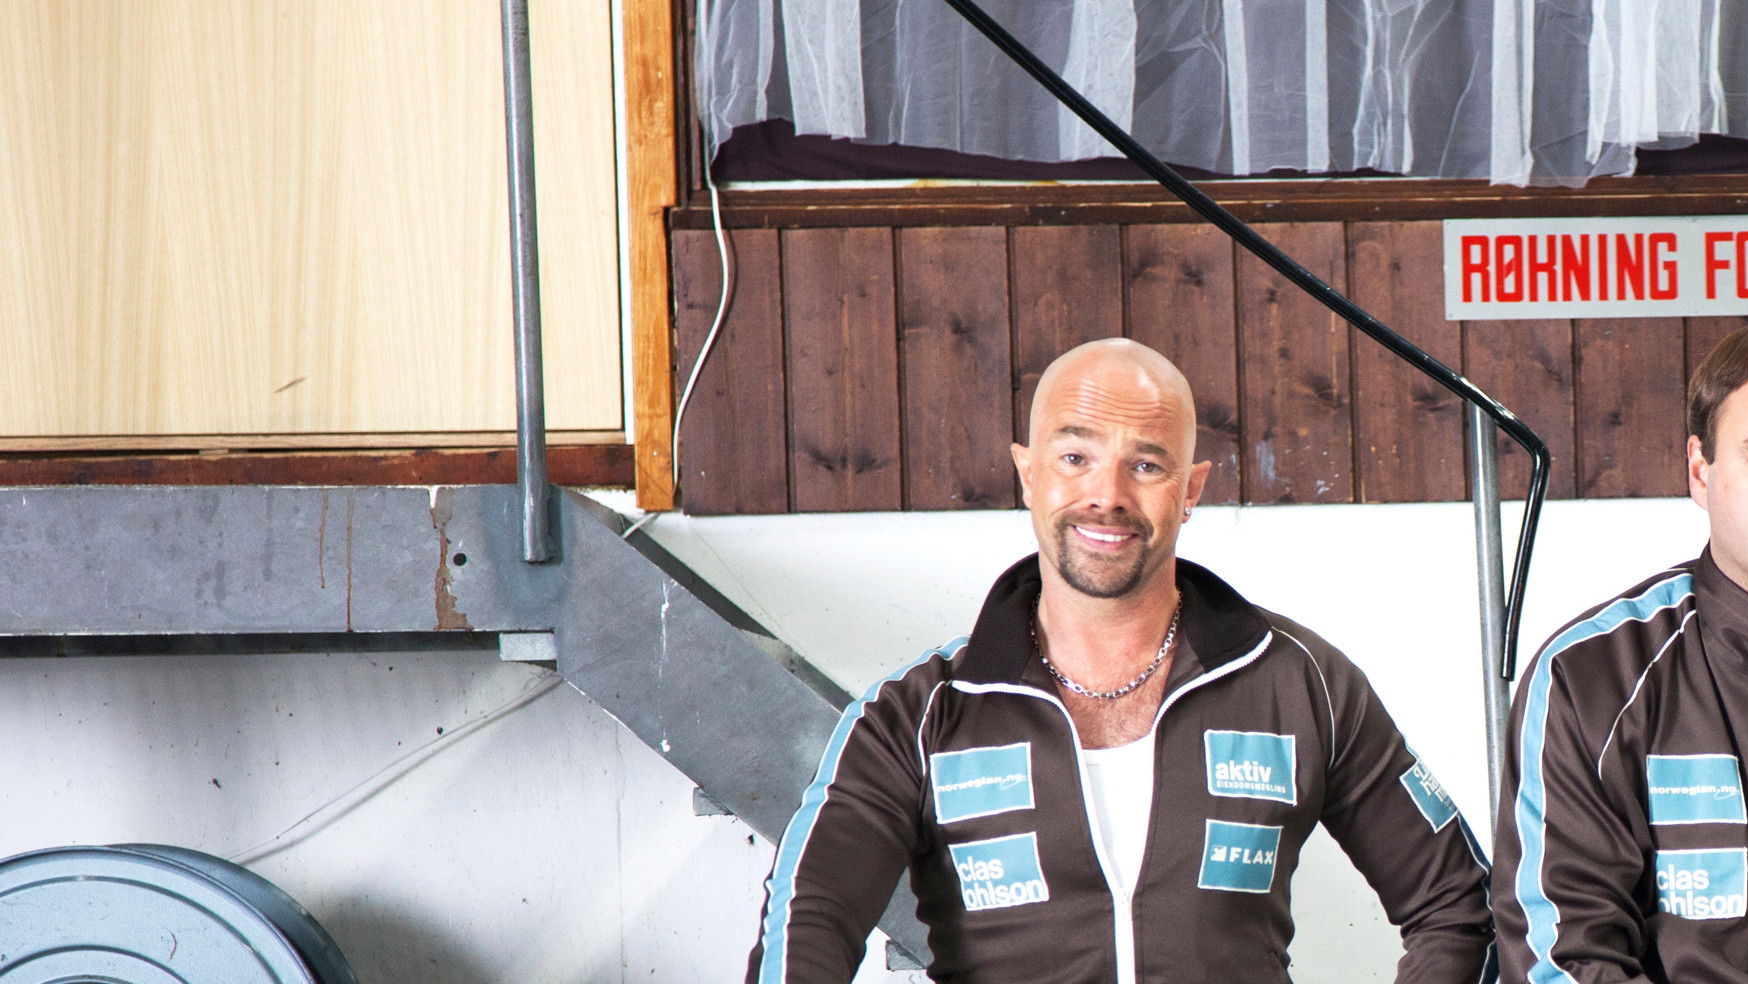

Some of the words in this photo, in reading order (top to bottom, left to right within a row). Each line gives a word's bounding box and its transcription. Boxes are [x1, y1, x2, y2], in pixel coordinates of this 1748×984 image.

[1461, 233, 1678, 303] RØKNING
[1215, 759, 1272, 783] aktiv
[1650, 785, 1737, 796] norwegian.no
[958, 856, 1005, 882] clas
[1229, 847, 1274, 865] FLAX
[1657, 864, 1710, 890] clas
[964, 880, 1043, 909] ohlson
